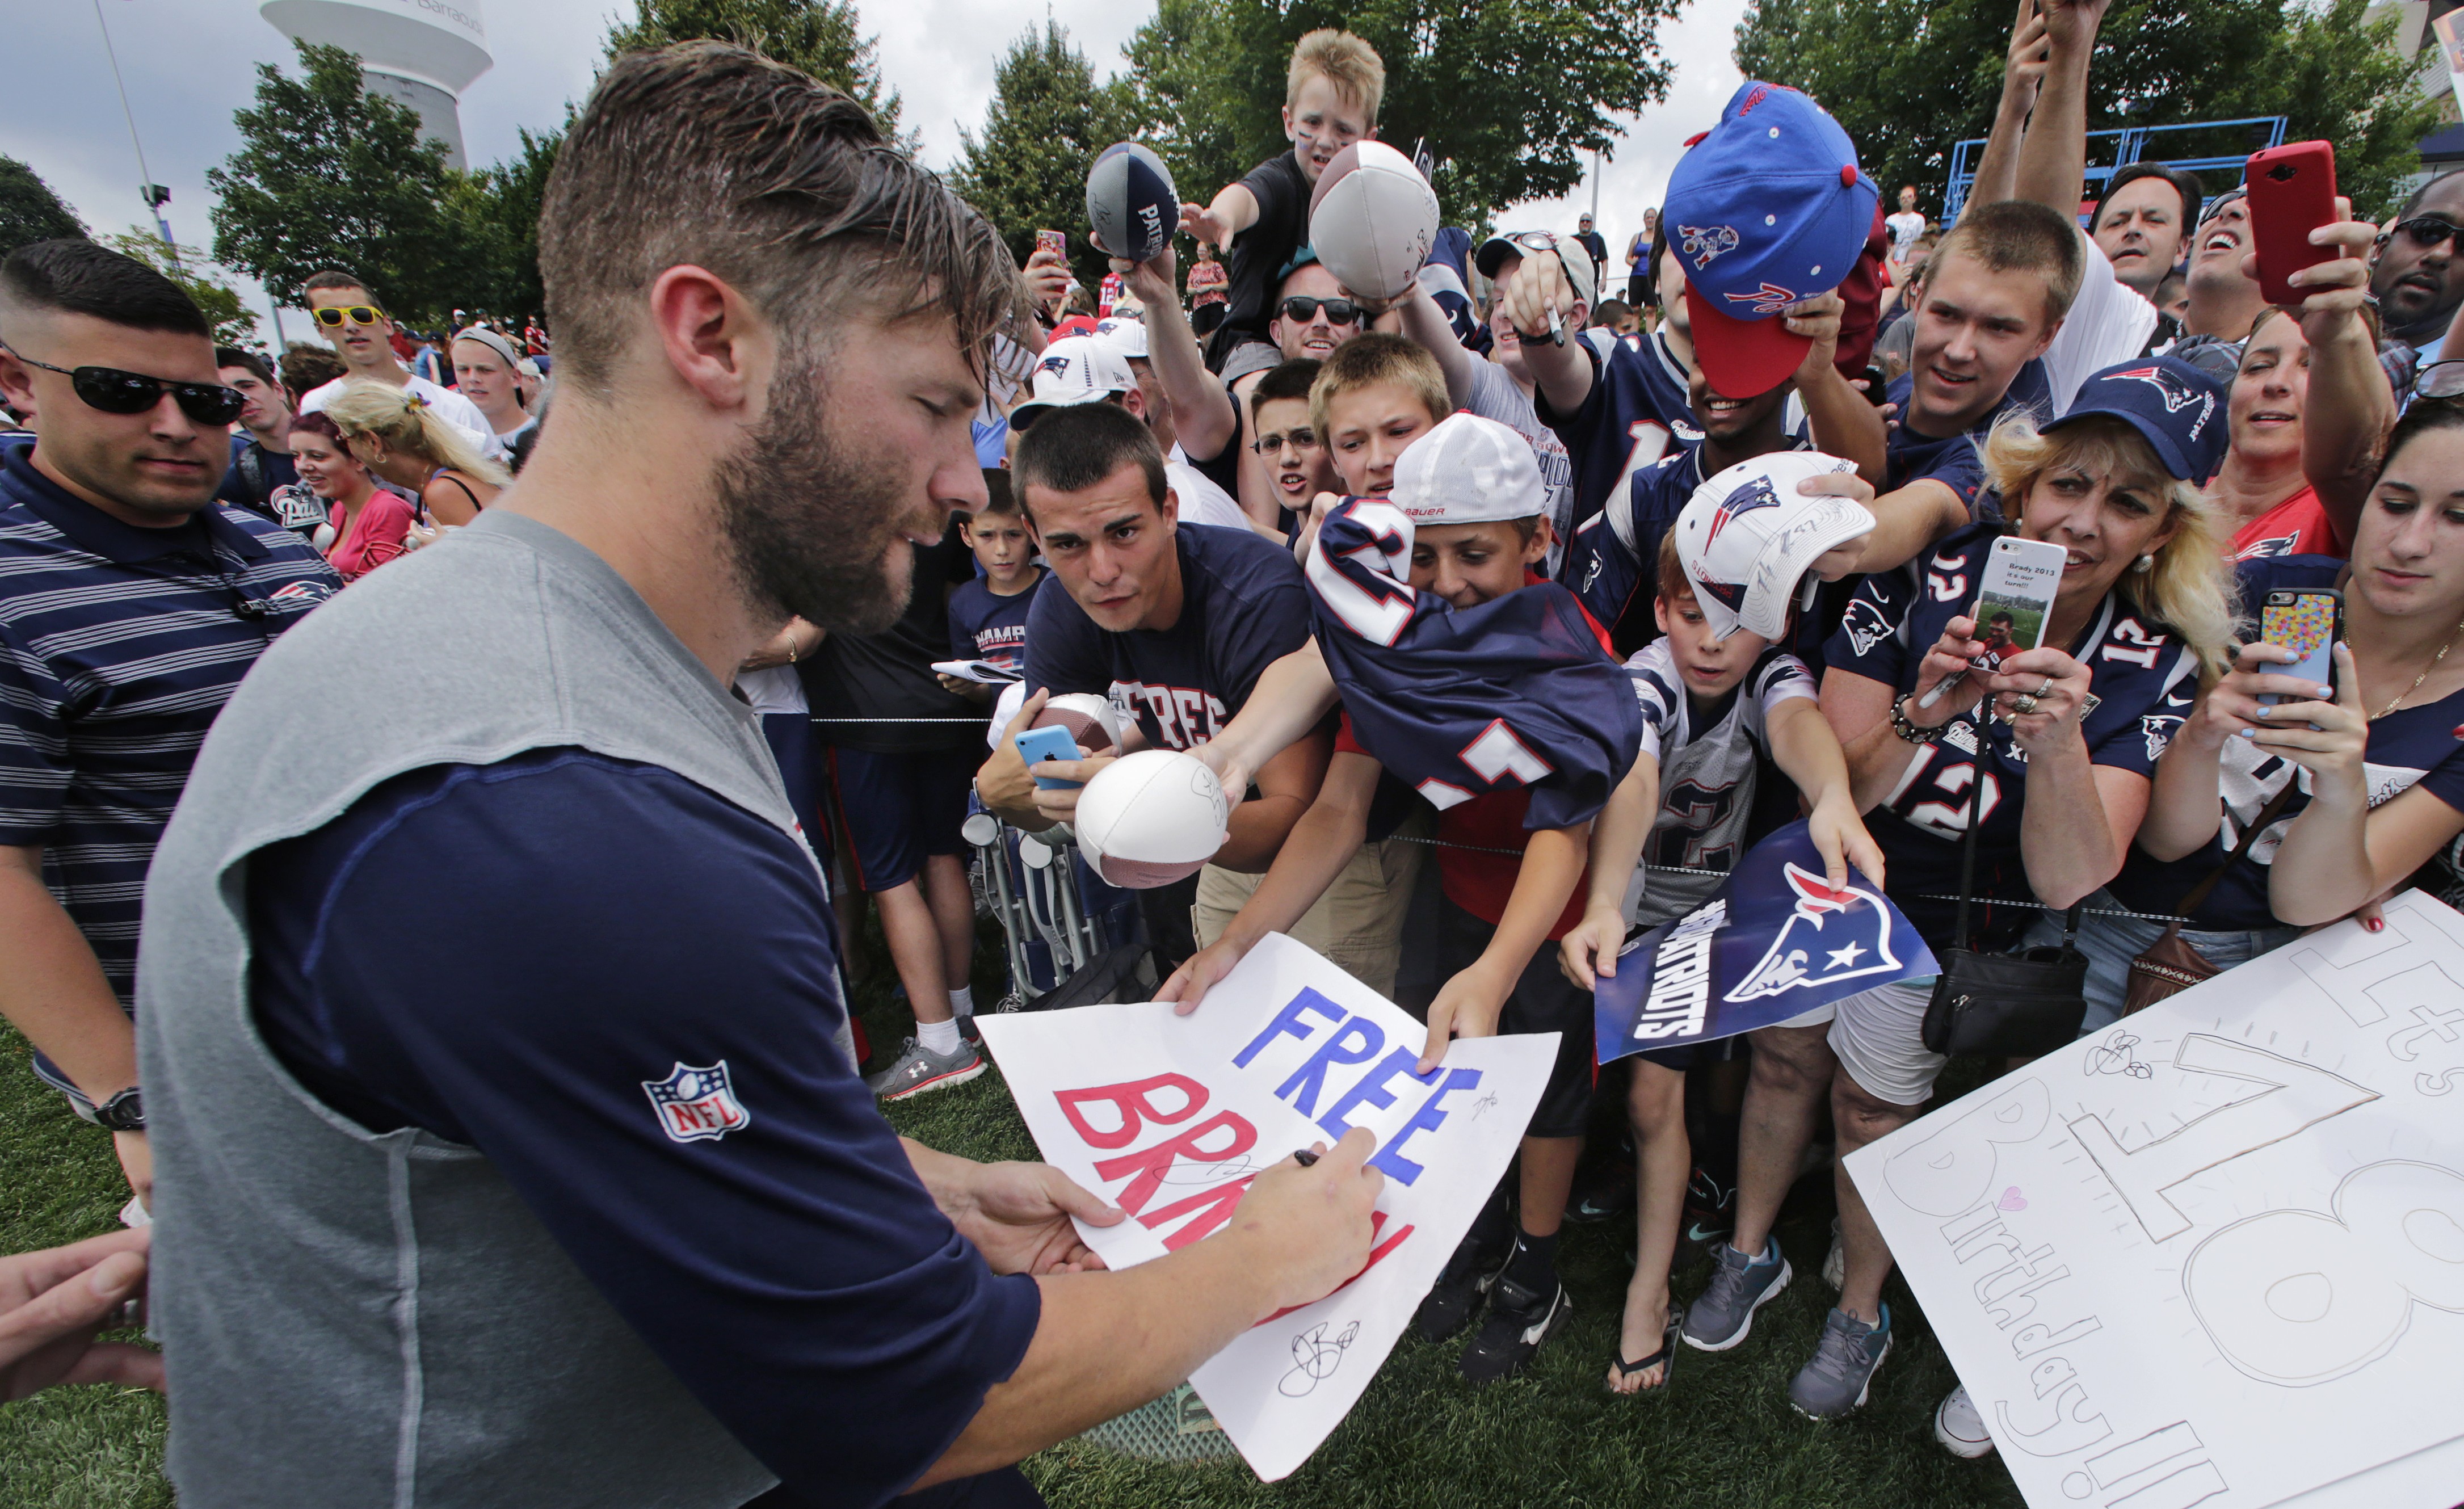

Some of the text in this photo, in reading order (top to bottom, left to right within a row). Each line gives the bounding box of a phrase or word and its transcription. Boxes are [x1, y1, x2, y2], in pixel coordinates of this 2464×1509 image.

[2189, 390, 2215, 443] PATRIOTS
[2009, 563, 2055, 577] Brady 2013
[972, 625, 1025, 648] HAMP
[2101, 616, 2170, 669] 12
[1231, 985, 1483, 1187] FREE
[668, 1096, 739, 1132] NFL
